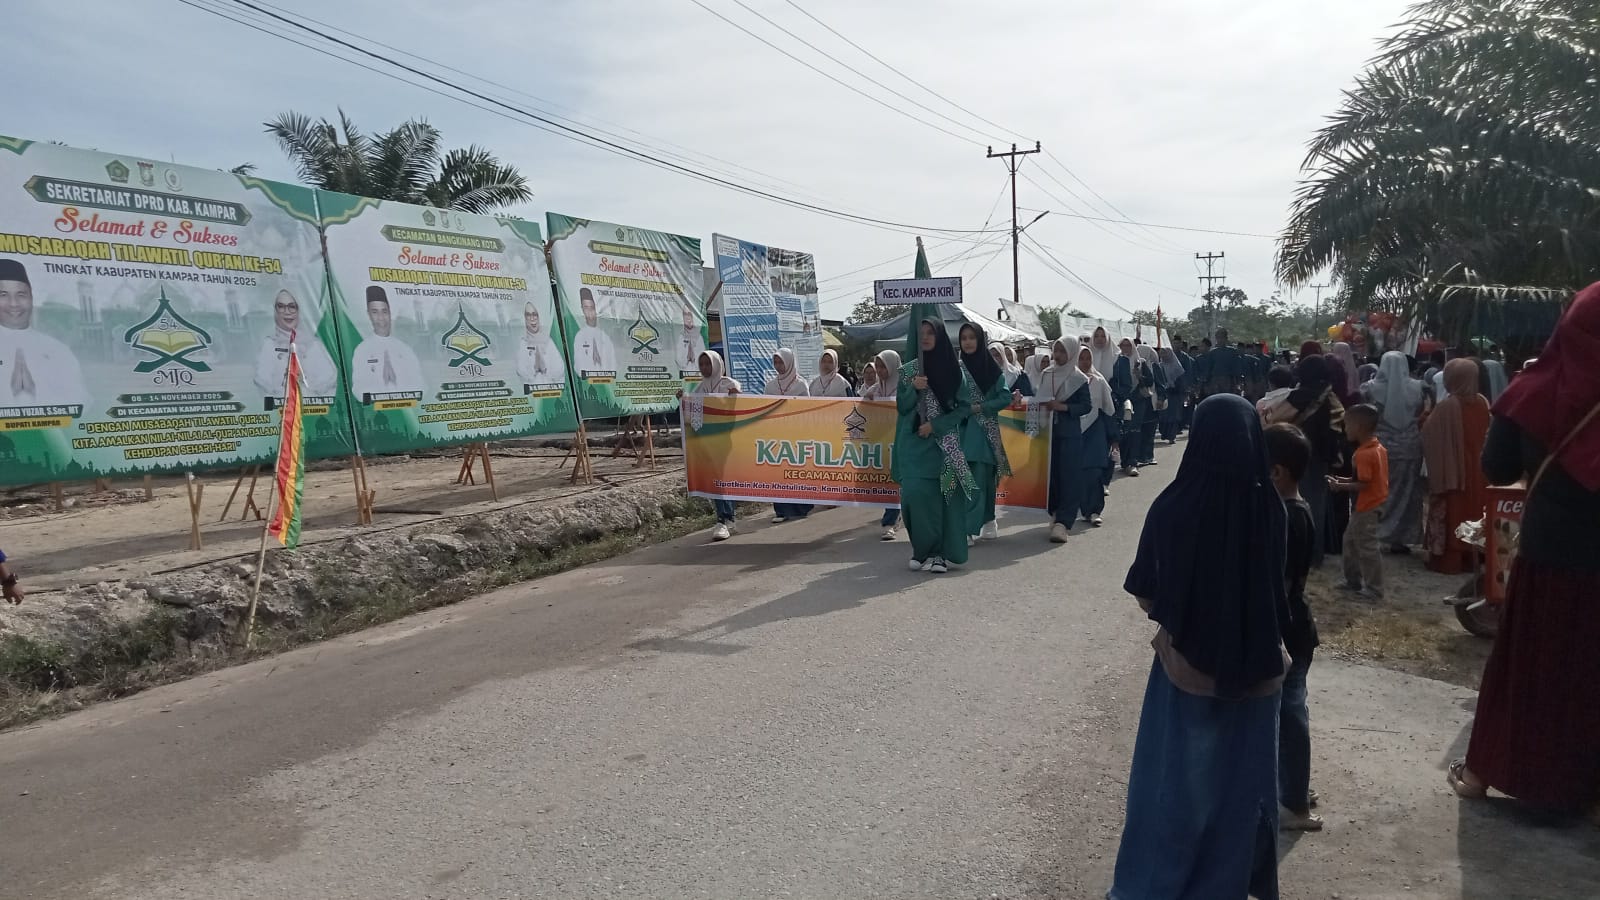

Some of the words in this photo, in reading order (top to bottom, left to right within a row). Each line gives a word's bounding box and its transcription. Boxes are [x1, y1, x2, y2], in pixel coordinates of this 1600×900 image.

[46, 181, 131, 208] SEKRETARIAT
[134, 194, 165, 212] DPRD
[168, 197, 193, 216] KAB.
[195, 201, 237, 221] KAMPAR
[54, 207, 145, 237] Selamat
[150, 220, 168, 239] &
[173, 220, 238, 248] Sukses
[391, 228, 437, 243] KECAMATAN
[437, 233, 481, 248] BANGKINANG
[482, 239, 498, 250] KOTA
[0, 233, 111, 260] MUSABAQAH
[111, 242, 192, 268] TILAWATIL
[193, 250, 243, 272] QUR'AN
[244, 255, 281, 275] KE-54
[398, 246, 446, 267] Selamat
[449, 254, 460, 268] &
[463, 253, 500, 271] Sukses
[598, 256, 631, 273] Selamat
[43, 262, 93, 276] TINGKAT
[95, 265, 157, 280] KABUPATEN
[158, 269, 200, 283] KAMPAR
[202, 273, 232, 286] TAHUN
[233, 276, 257, 287] 2025
[369, 267, 430, 286] MUSABAQAH
[395, 287, 421, 297] TINGKAT
[422, 289, 456, 299] KABUPATEN
[882, 288, 901, 299] KEC.
[902, 287, 937, 298] KAMPAR
[938, 286, 954, 297] KIRI
[149, 394, 159, 402] 14
[161, 392, 201, 401] NOVEMBER
[117, 408, 127, 417] DI
[127, 405, 178, 416] KECAMATAN
[179, 404, 211, 413] KAMPAR
[212, 403, 236, 412] UTARA
[72, 437, 99, 450] KITA
[755, 438, 883, 470] KAFILAH
[784, 470, 852, 482] KECAMATAN
[853, 473, 896, 484] KAMPA
[752, 481, 770, 490] Kota
[821, 485, 841, 494] Kami
[842, 486, 870, 497] Datang
[871, 487, 897, 496] Bukan
